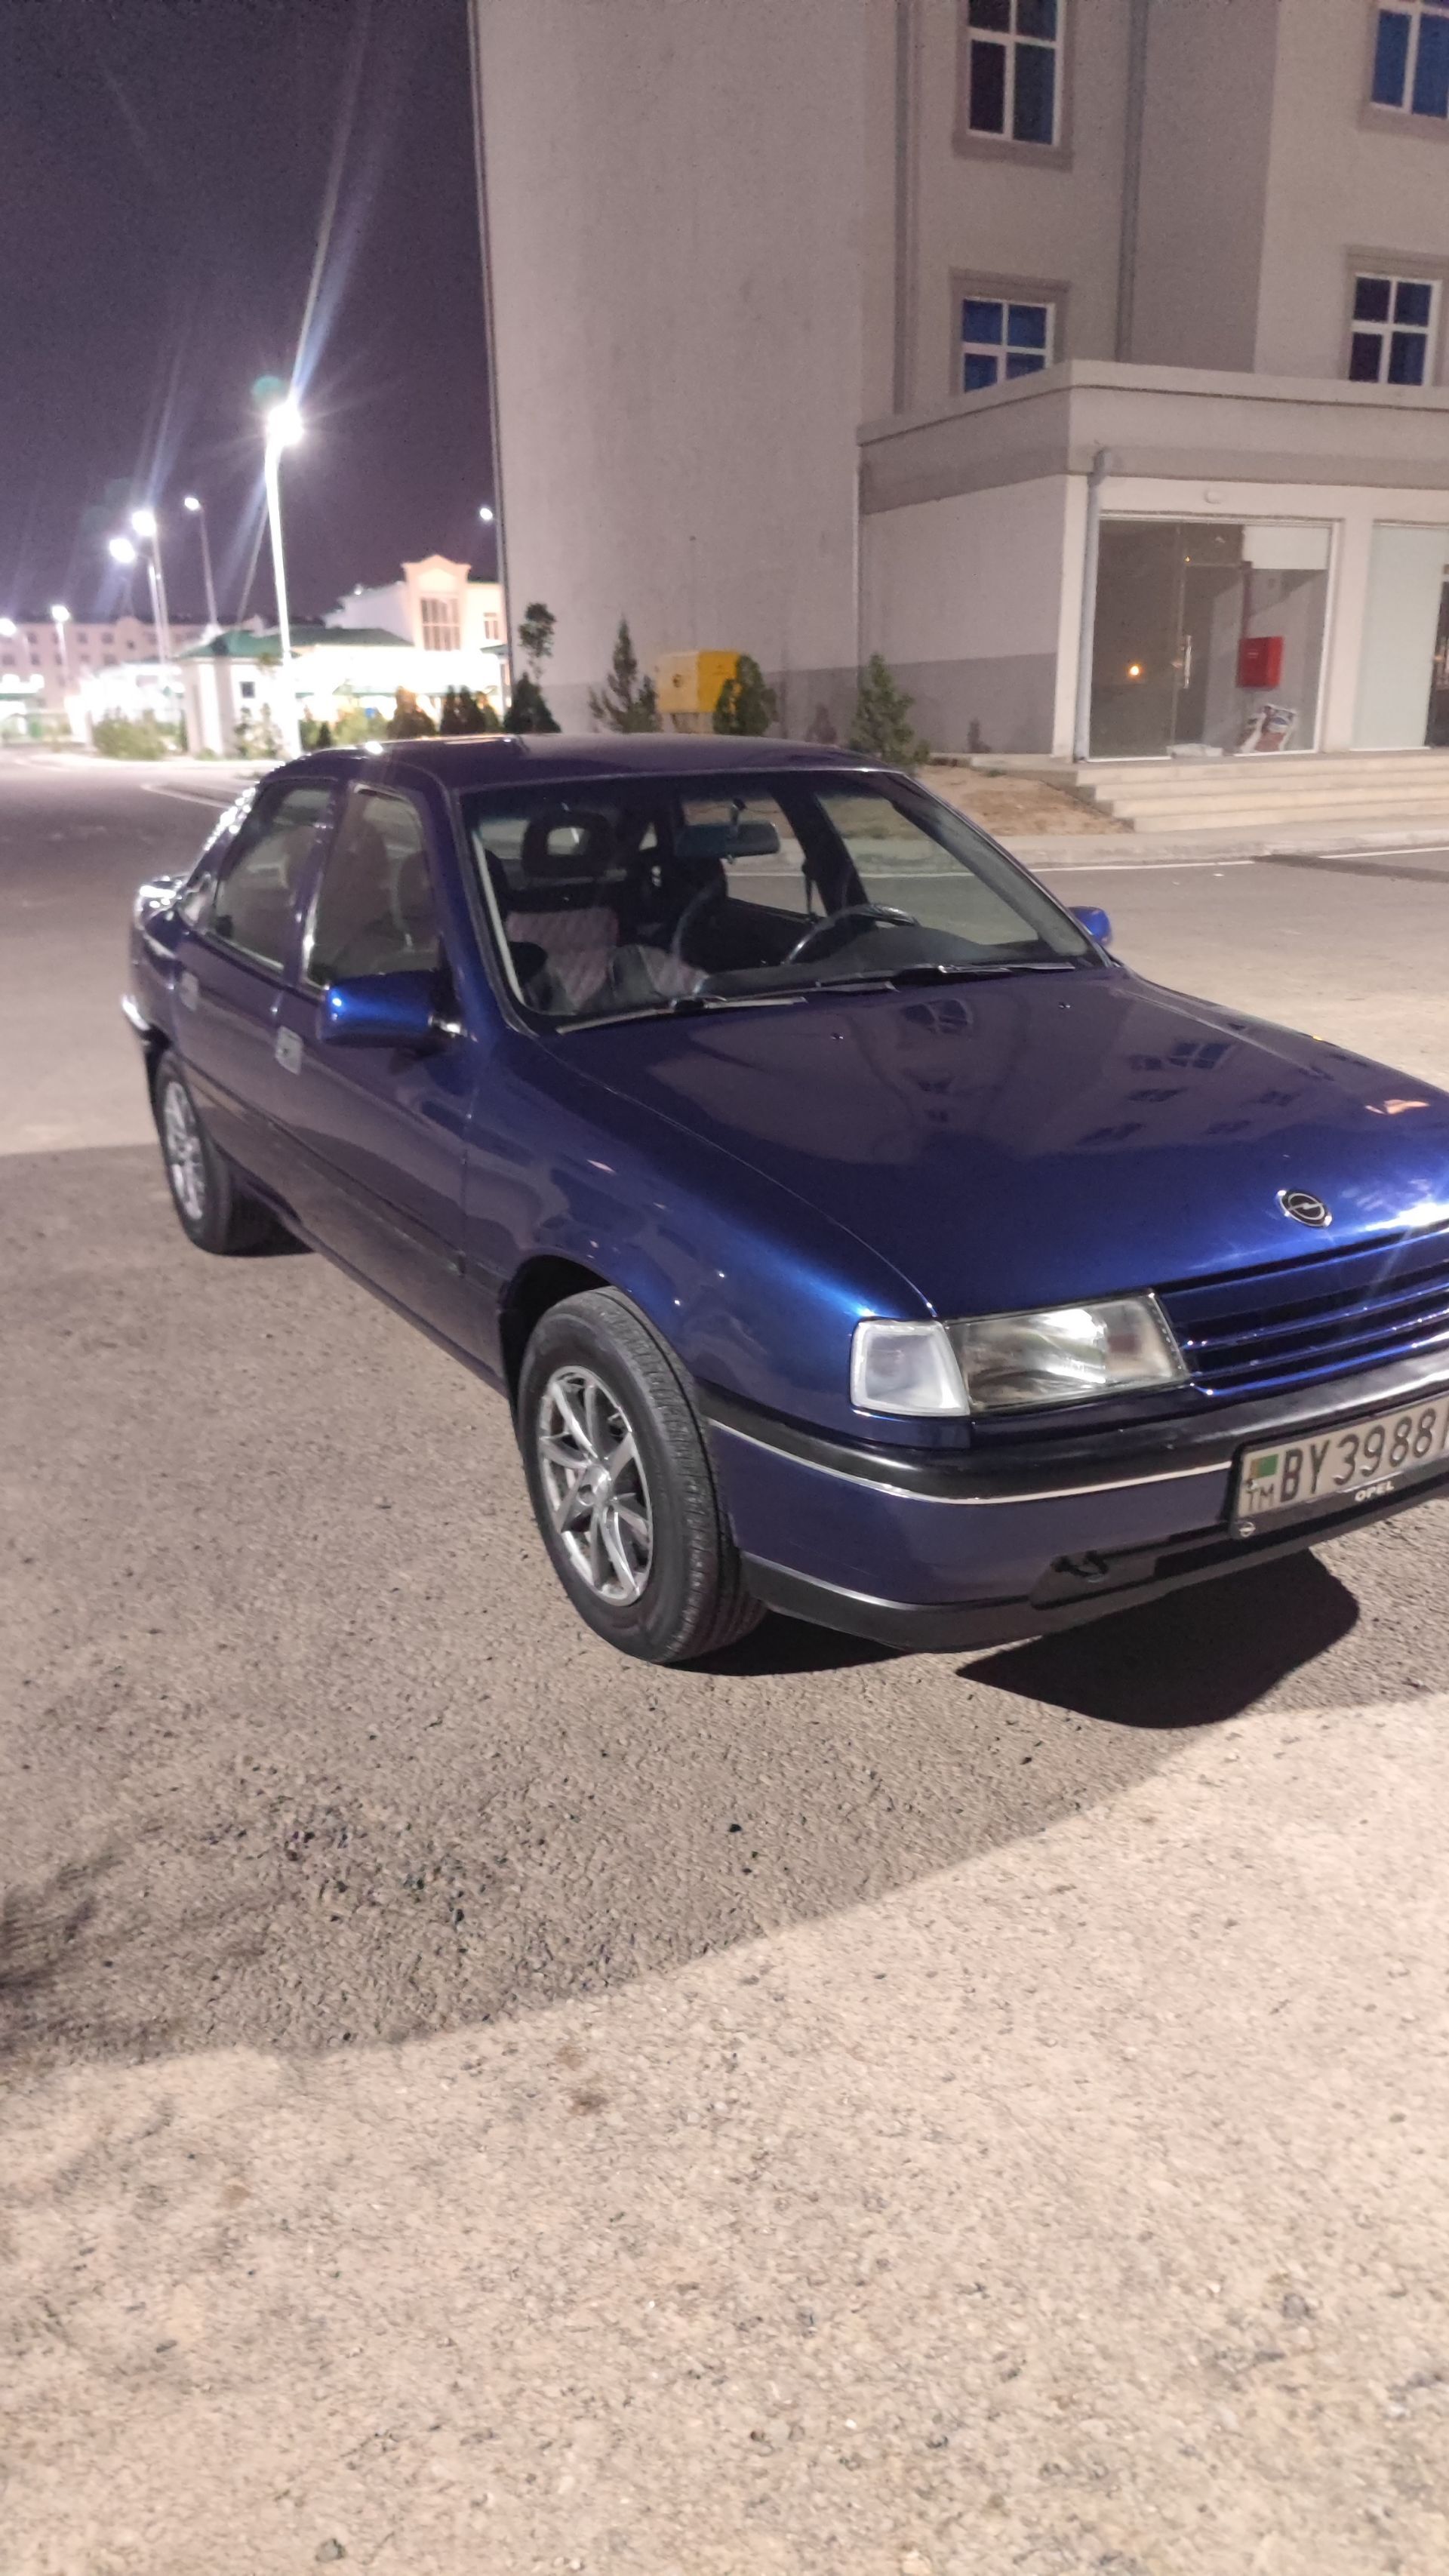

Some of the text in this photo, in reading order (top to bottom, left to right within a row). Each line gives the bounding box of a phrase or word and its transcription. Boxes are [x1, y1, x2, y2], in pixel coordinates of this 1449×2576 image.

[1280, 1401, 1449, 1503] BY3988
[1245, 1483, 1275, 1511] TM
[1354, 1480, 1395, 1502] OPEL
